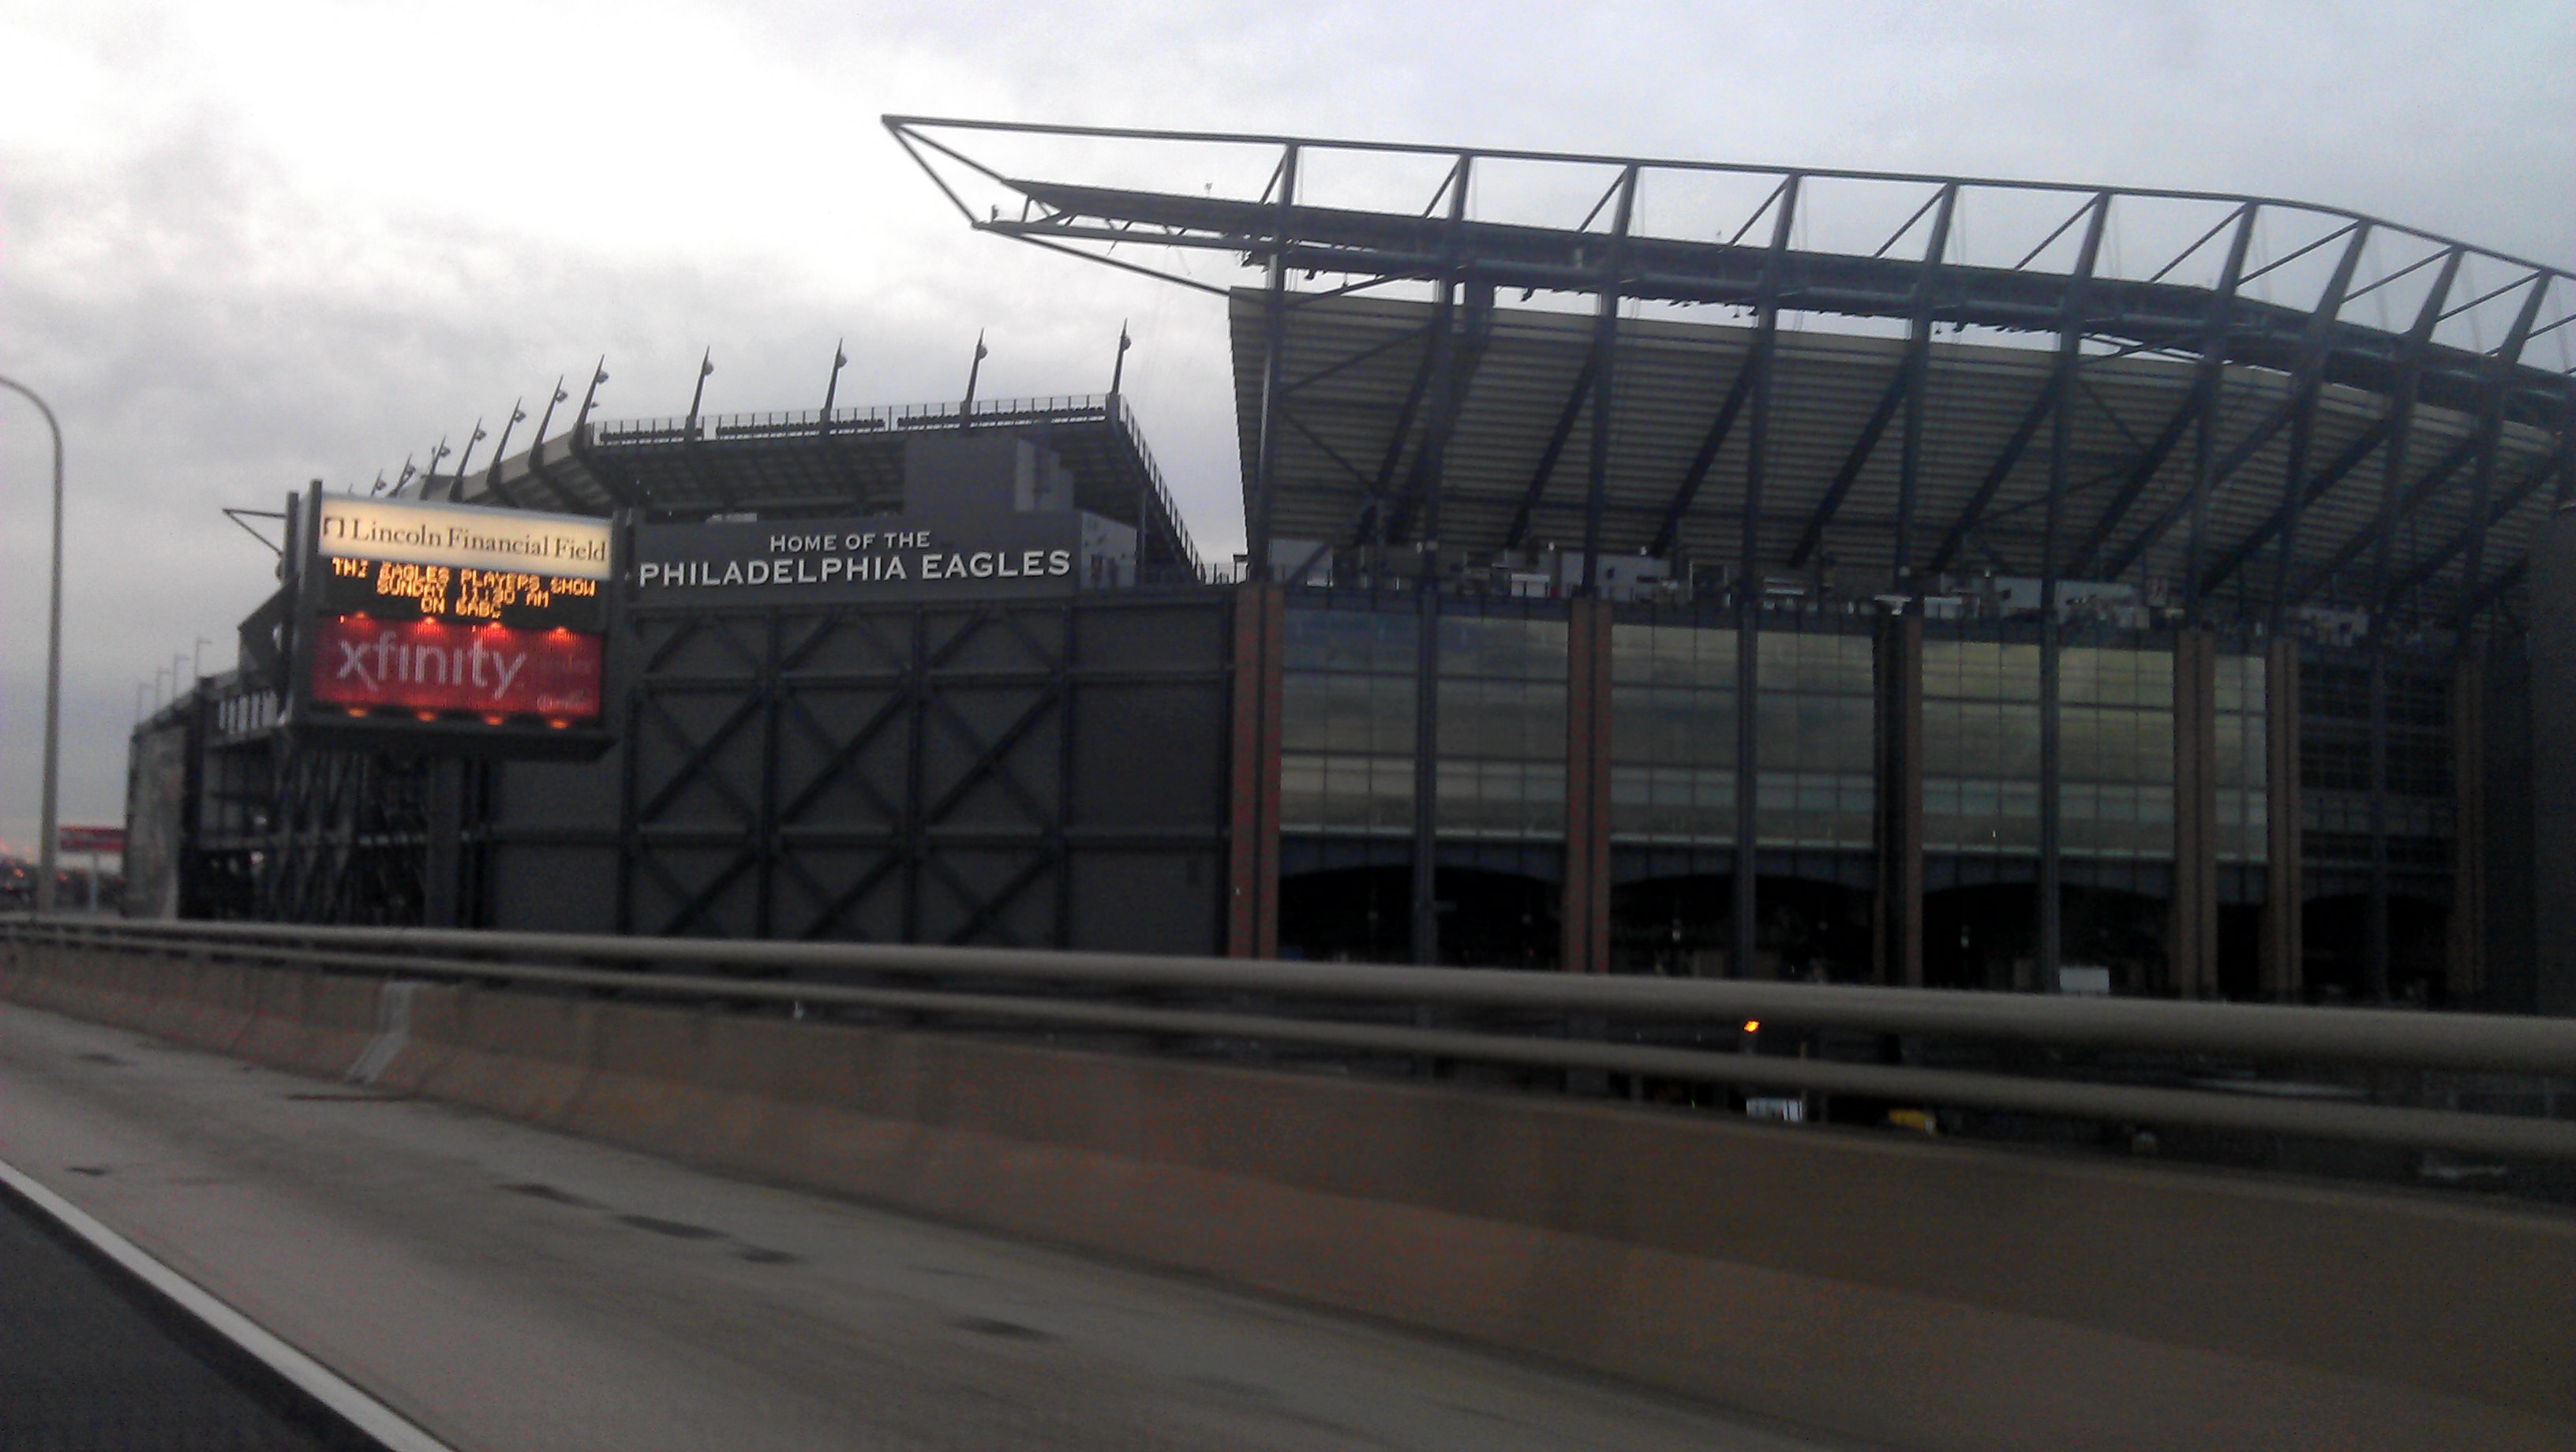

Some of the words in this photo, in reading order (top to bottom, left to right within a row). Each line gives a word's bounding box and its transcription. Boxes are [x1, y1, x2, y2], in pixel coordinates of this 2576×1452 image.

[353, 518, 441, 547] Lincoln
[447, 527, 549, 556] Financial
[554, 537, 606, 562] Field
[769, 534, 837, 552] HOME
[845, 533, 875, 551] OF
[884, 530, 931, 548] THE
[638, 555, 908, 587] PHILADELPHIA
[921, 550, 1072, 579] EAGLES
[551, 576, 597, 597] SHOW
[421, 595, 446, 615] ON
[526, 589, 550, 608] AM
[337, 631, 528, 701] xfinity
